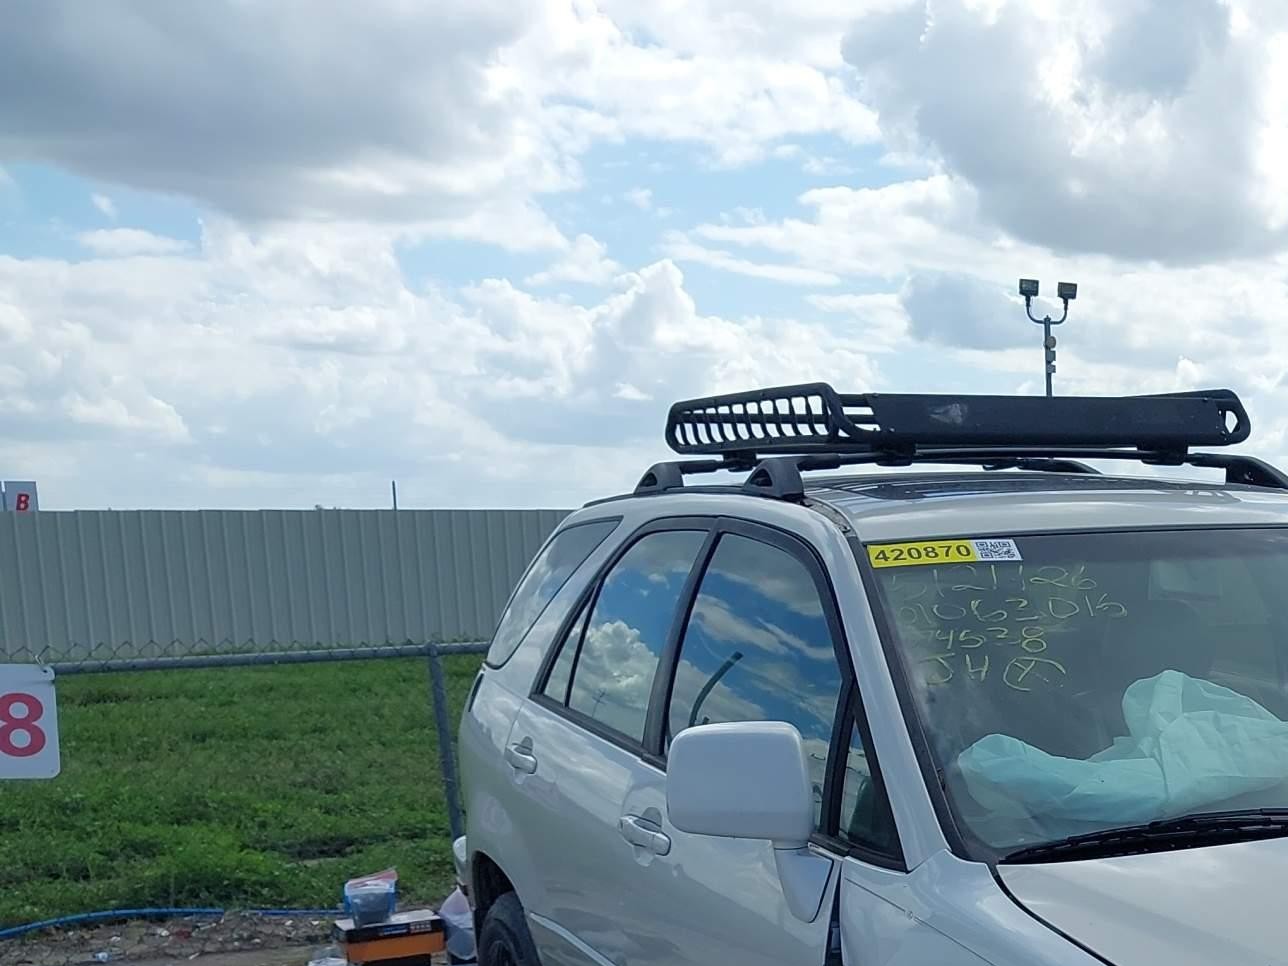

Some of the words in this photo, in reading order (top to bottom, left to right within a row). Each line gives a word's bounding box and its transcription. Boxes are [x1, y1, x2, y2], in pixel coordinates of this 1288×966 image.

[16, 493, 30, 511] B
[874, 545, 971, 562] 420870
[0, 693, 46, 757] 8
